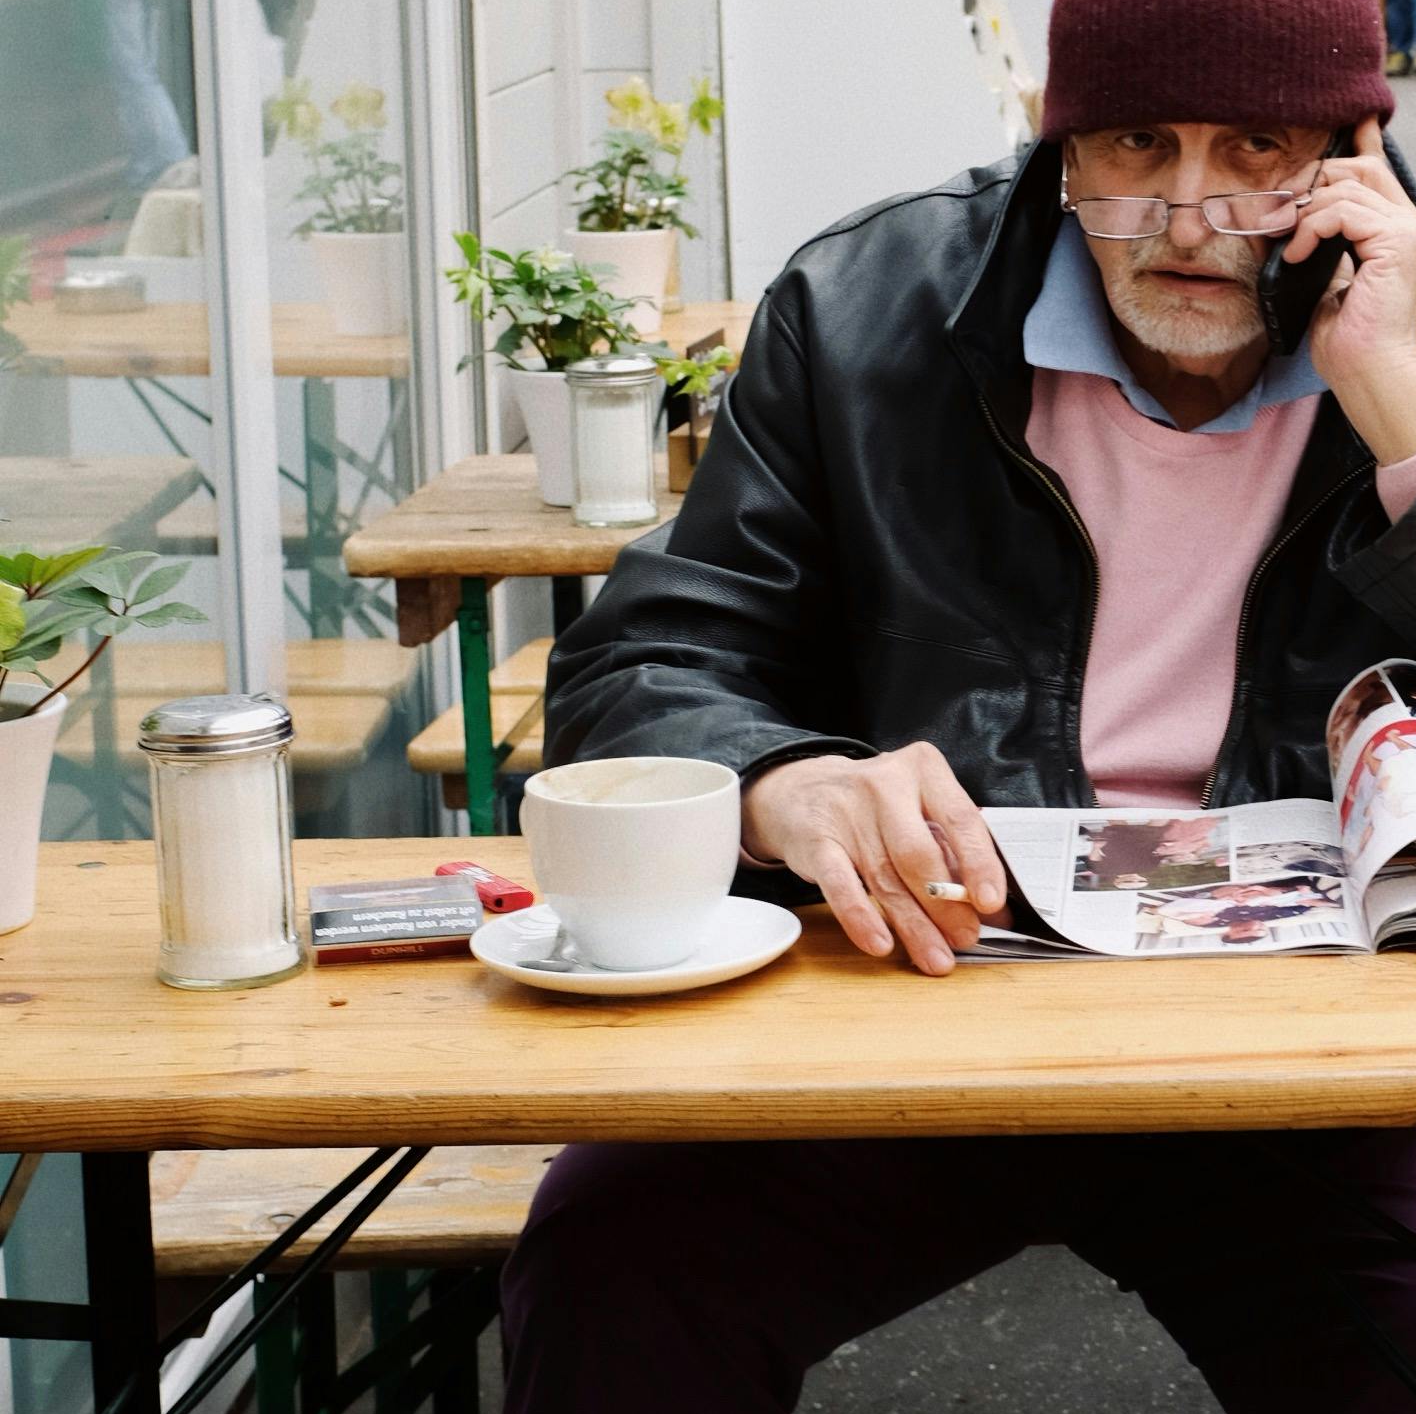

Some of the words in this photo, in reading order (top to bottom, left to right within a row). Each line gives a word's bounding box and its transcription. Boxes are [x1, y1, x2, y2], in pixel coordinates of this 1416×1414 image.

[352, 910, 407, 923] Rauchern
[360, 922, 415, 934] Rauchern
[415, 919, 438, 929] von
[439, 918, 478, 929] Kinder
[314, 926, 360, 938] werden
